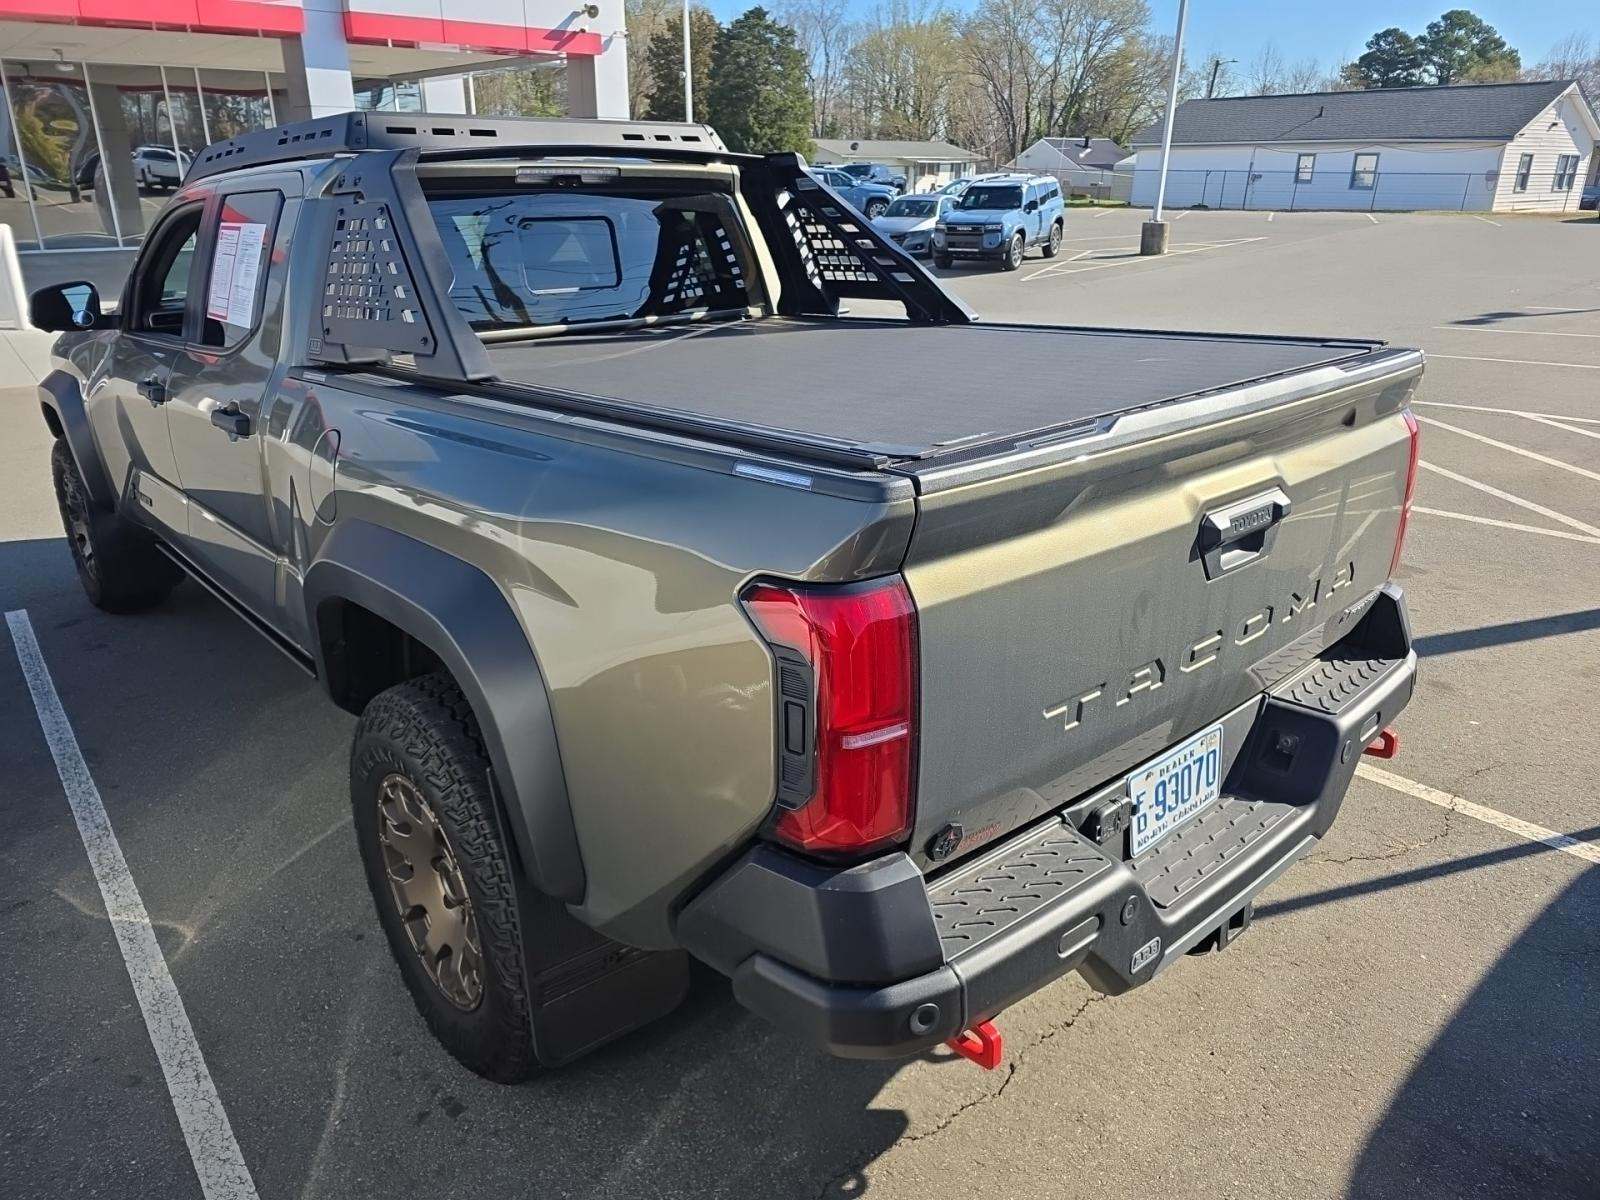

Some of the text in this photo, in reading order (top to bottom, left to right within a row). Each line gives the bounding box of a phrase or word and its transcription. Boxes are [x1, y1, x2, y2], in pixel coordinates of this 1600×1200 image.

[1231, 506, 1272, 534] TOYOTA
[1043, 561, 1354, 730] TACOMA
[1159, 750, 1195, 778] DEALER
[1137, 790, 1215, 849] NORTH CAROLINA
